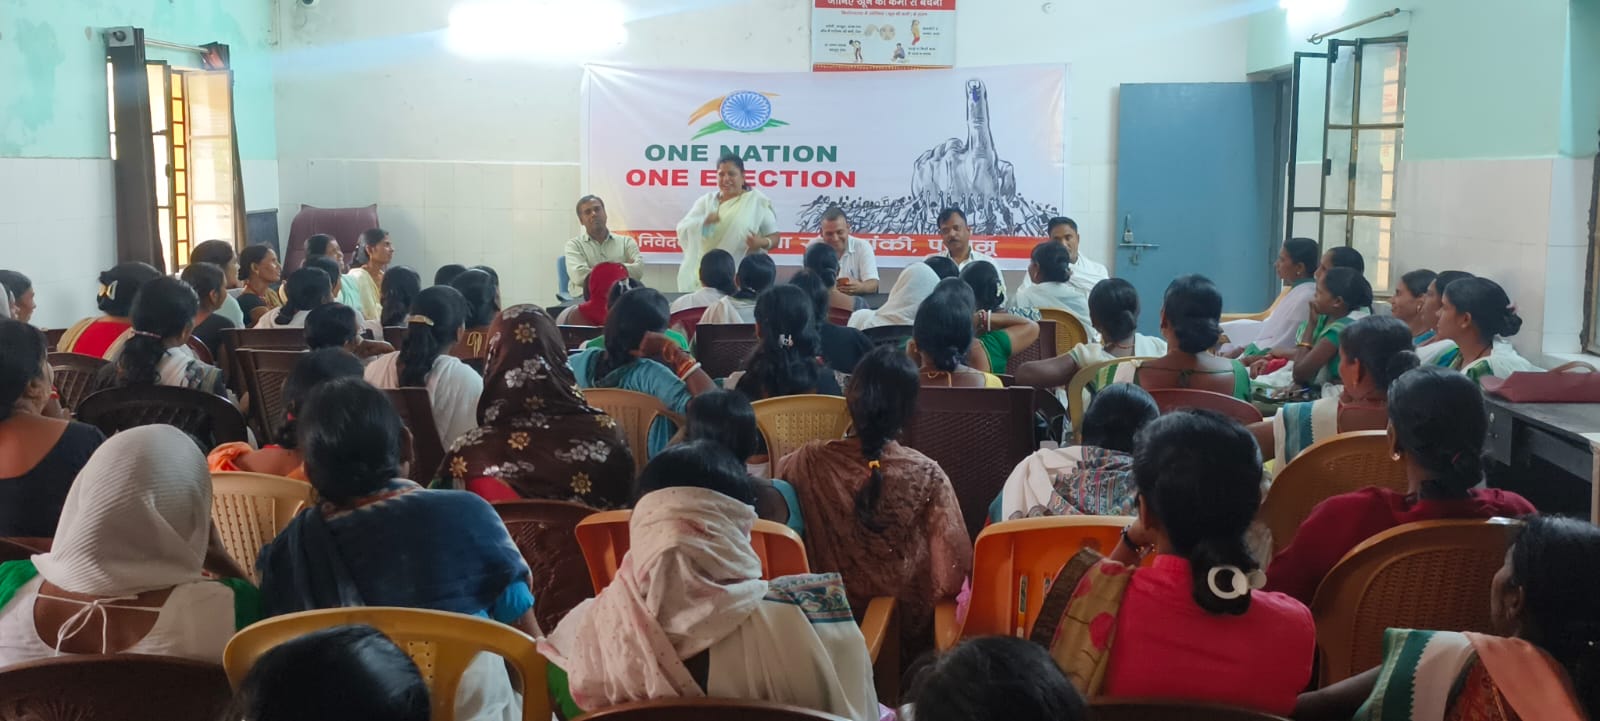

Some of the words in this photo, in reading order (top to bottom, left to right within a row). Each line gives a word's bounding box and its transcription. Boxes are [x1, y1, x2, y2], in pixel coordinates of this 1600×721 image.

[644, 144, 708, 162] ONE
[720, 144, 838, 163] NATION
[625, 169, 688, 187] ONE
[700, 169, 856, 188] EECTION
[638, 232, 679, 249] निवेद
